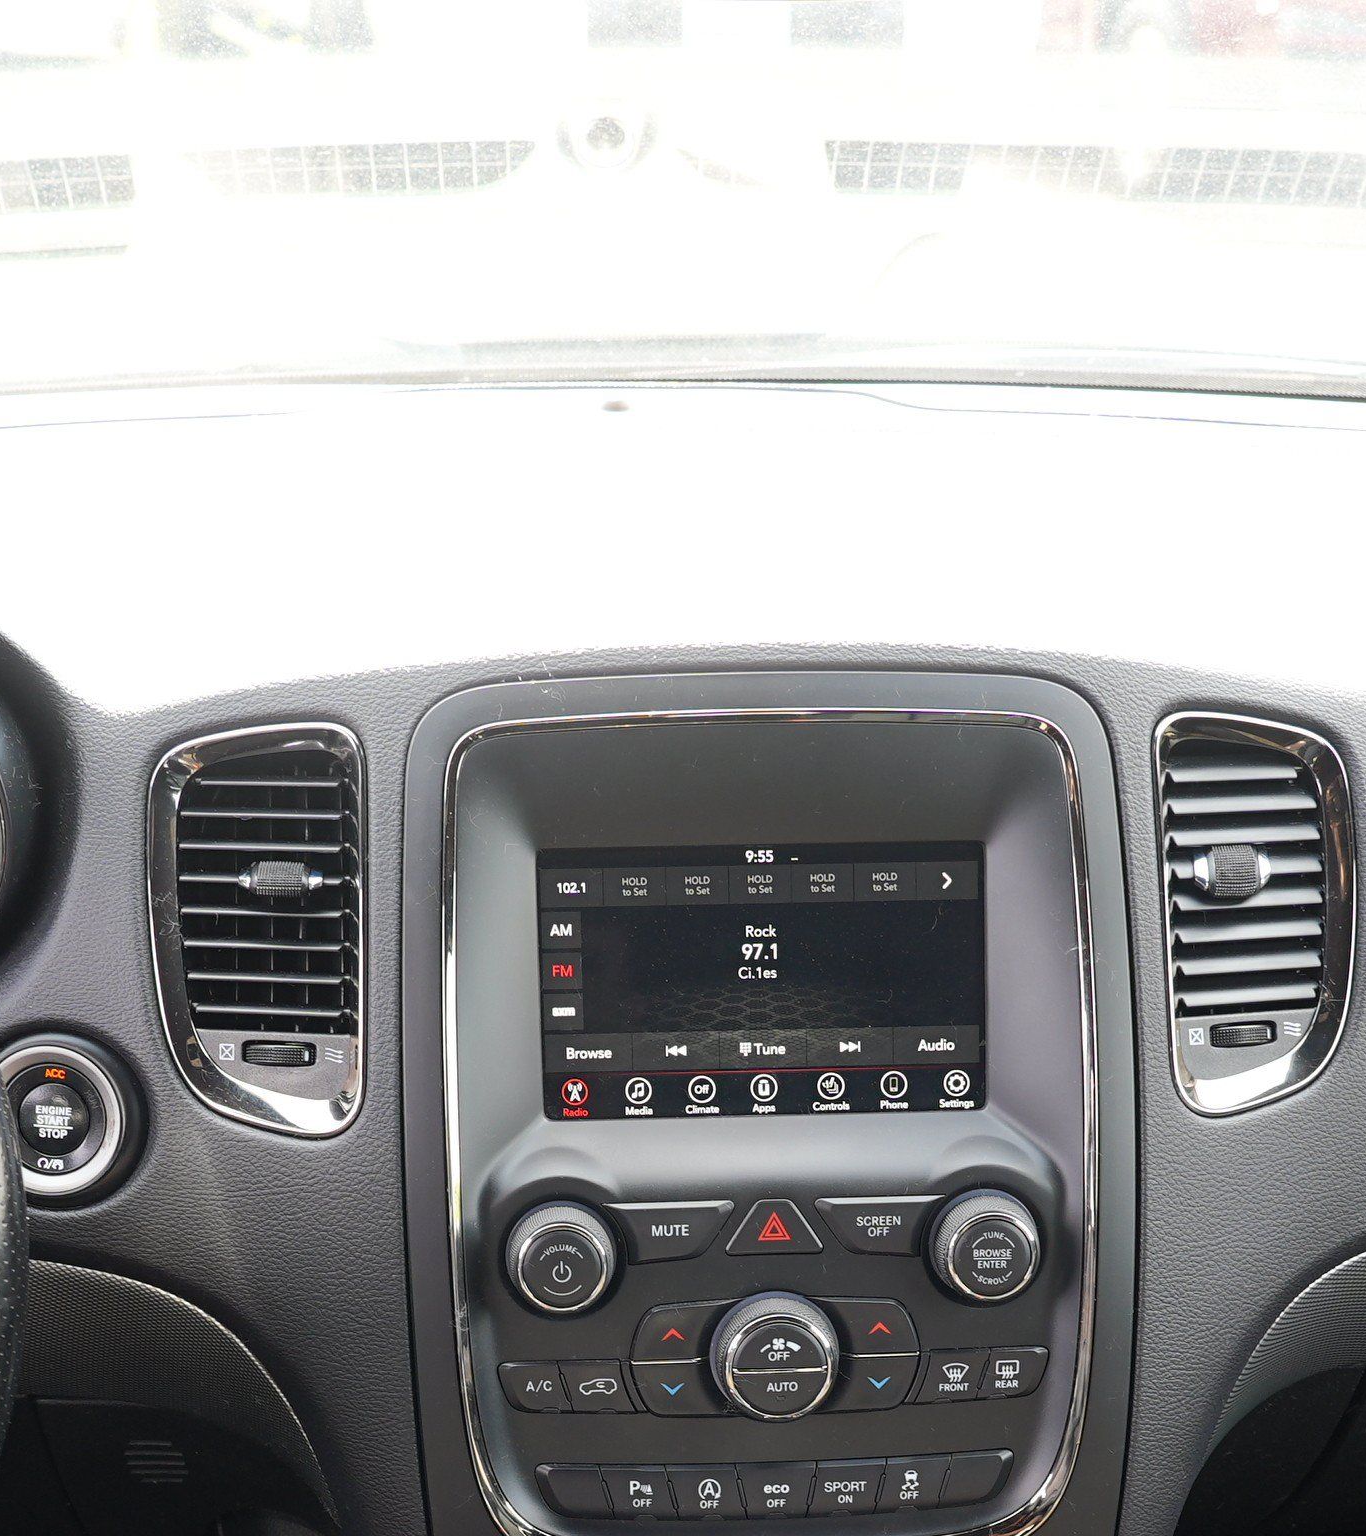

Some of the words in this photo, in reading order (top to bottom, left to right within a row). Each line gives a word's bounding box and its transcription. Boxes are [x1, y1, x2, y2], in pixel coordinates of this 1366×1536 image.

[745, 850, 774, 863] 9:55
[622, 877, 648, 886] HOLD
[685, 876, 710, 885] HOLD
[747, 875, 773, 884] HOLD
[810, 874, 835, 882] HOLD
[872, 873, 897, 881] HOLD
[557, 882, 586, 894] 102.1
[633, 888, 648, 896] Set
[685, 887, 694, 895] to
[696, 887, 710, 895] Set
[748, 886, 757, 894] to
[759, 885, 773, 894] Set
[810, 885, 819, 893] to
[821, 884, 835, 892] Set
[873, 883, 881, 891] to
[883, 883, 897, 891] Set
[550, 924, 573, 937] AM
[745, 924, 777, 938] Rock
[741, 943, 778, 960] 97.1
[552, 965, 574, 978] FM
[738, 966, 777, 979] Ci.1es
[753, 1042, 786, 1056] Tune
[917, 1038, 955, 1052] Audio
[566, 1047, 612, 1060] Browse
[45, 1069, 66, 1079] ACC
[694, 1084, 710, 1095] Off
[752, 1103, 776, 1114] Apps
[812, 1101, 850, 1111] Controls
[880, 1100, 909, 1110] Phone
[939, 1098, 975, 1109] Settings
[36, 1105, 72, 1116] ENGINE
[562, 1107, 589, 1117] Radio
[625, 1106, 653, 1116] Media
[685, 1104, 720, 1114] Climate
[36, 1115, 70, 1126] START
[39, 1128, 68, 1139] STOP
[856, 1215, 901, 1227] SCREEN
[651, 1224, 690, 1237] MUTE
[867, 1227, 890, 1237] OFF
[983, 1231, 1006, 1241] TUNE
[543, 1244, 578, 1257] VOLUME
[973, 1248, 1012, 1258] BROWSE
[977, 1260, 1007, 1269] ENTER
[977, 1274, 1008, 1286] SCROLL
[768, 1351, 790, 1362] OFF
[526, 1380, 553, 1393] A/C
[766, 1381, 798, 1393] AUTO
[939, 1382, 969, 1393] FRONT
[995, 1379, 1019, 1389] REAR
[763, 1483, 789, 1494] eco
[824, 1481, 867, 1493] SPORT
[837, 1494, 853, 1504] ON
[899, 1490, 919, 1500] OFF
[632, 1498, 652, 1508] OFF
[699, 1499, 719, 1509] OFF
[766, 1498, 786, 1508] OFF
